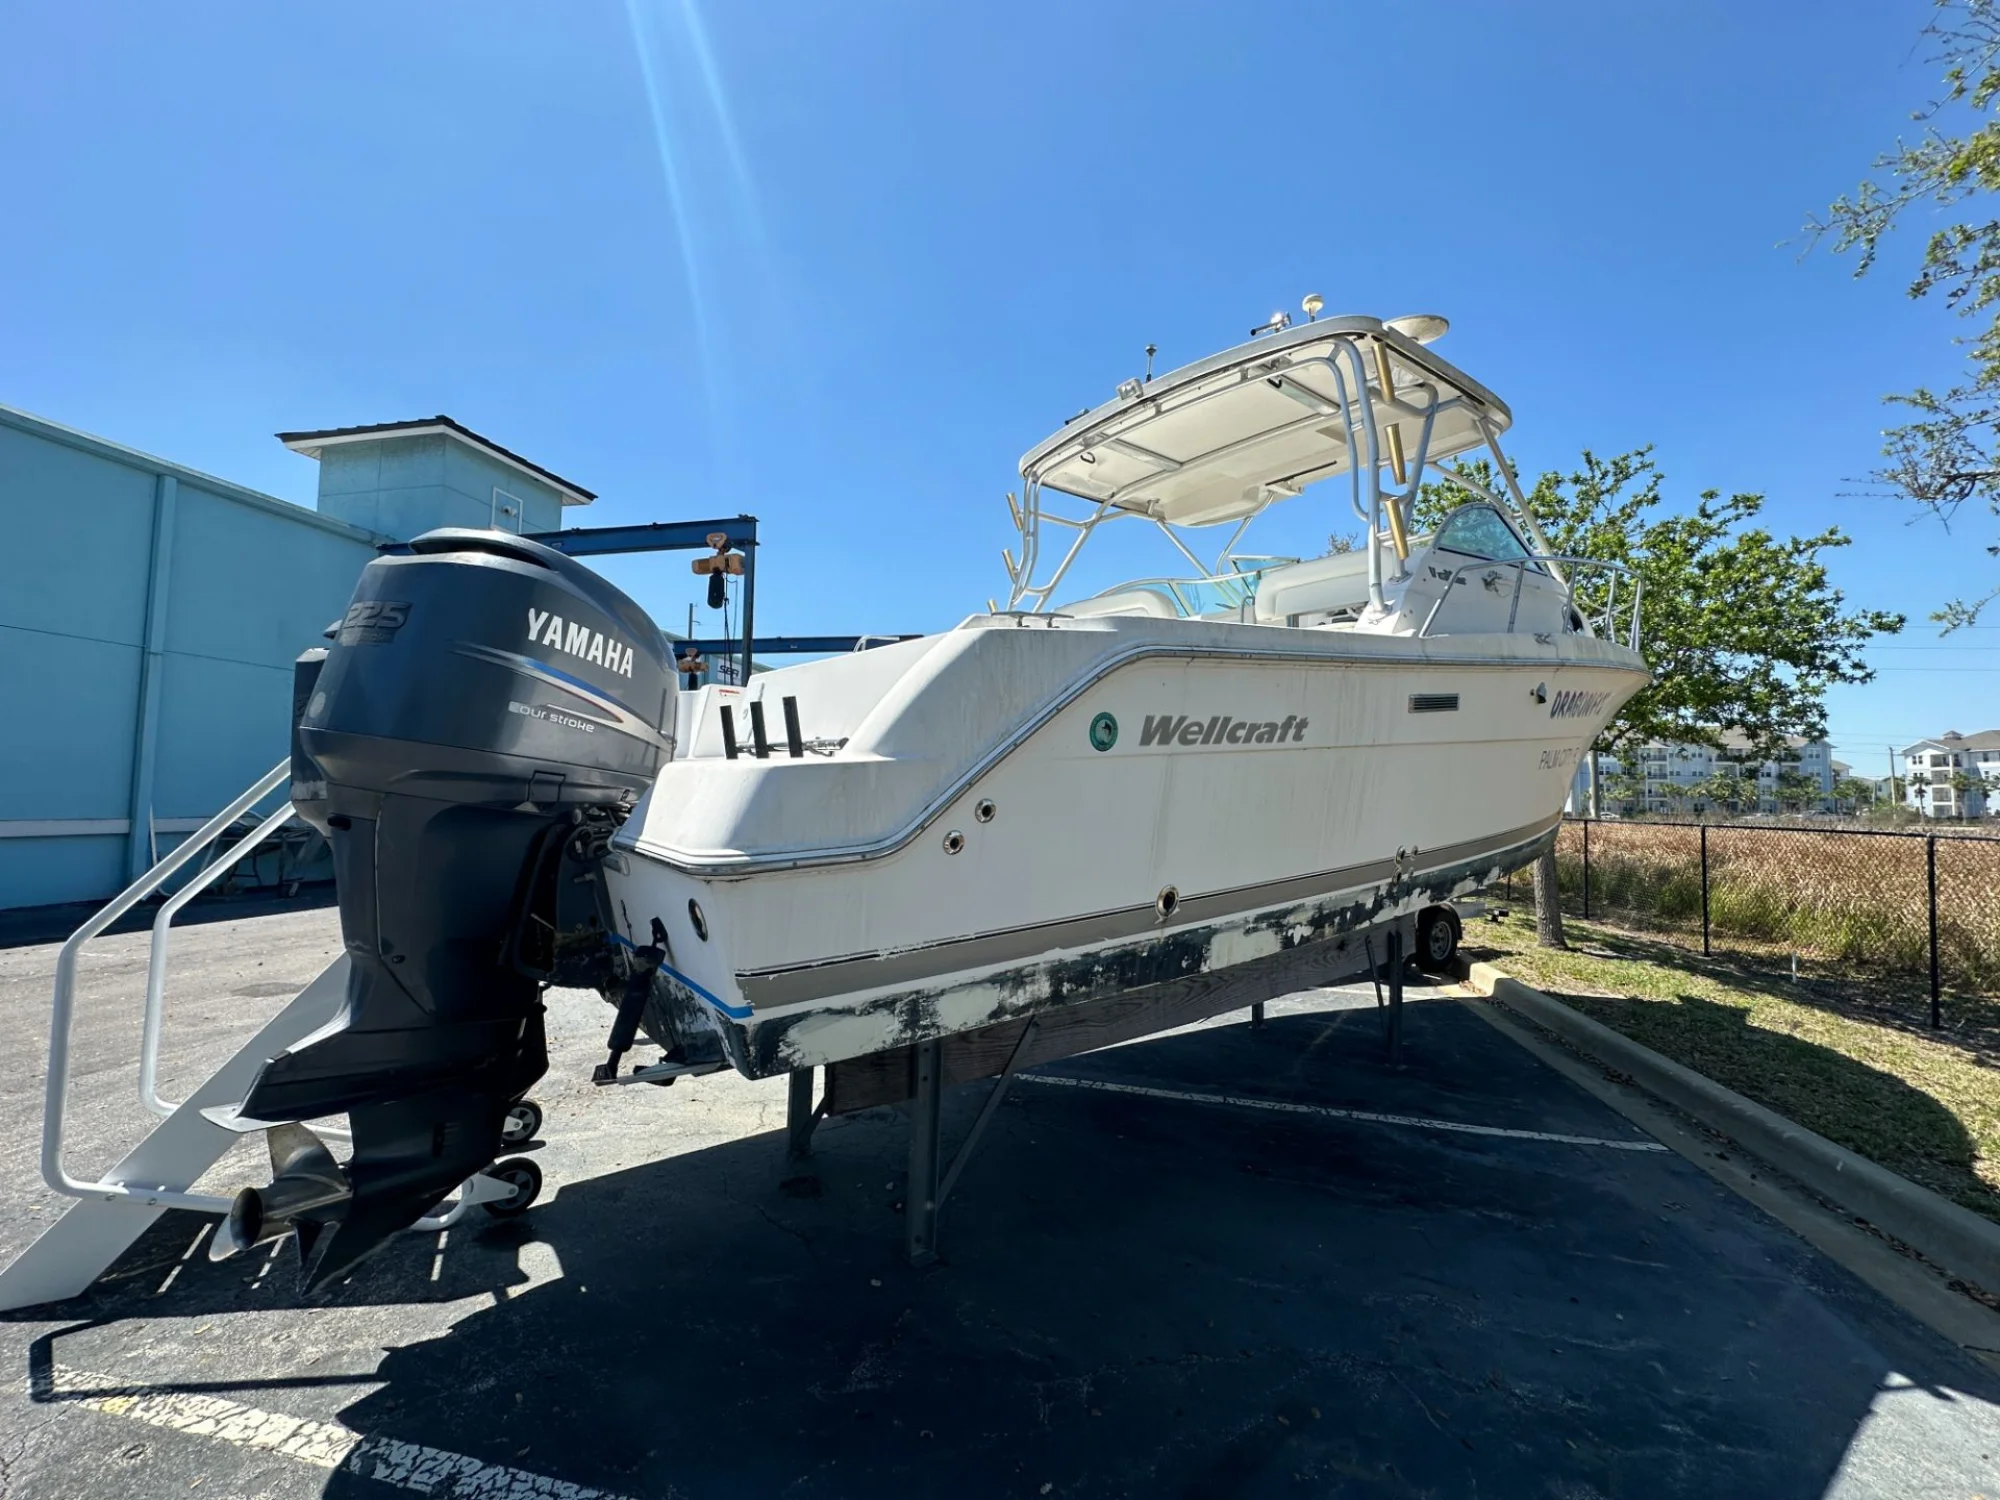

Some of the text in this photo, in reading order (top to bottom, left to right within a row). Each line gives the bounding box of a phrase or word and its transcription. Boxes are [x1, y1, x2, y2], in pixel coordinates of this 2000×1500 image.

[343, 601, 411, 629] 225
[528, 608, 634, 678] YAMAHA
[549, 713, 595, 733] stroke
[1139, 715, 1310, 747] Wellcraft
